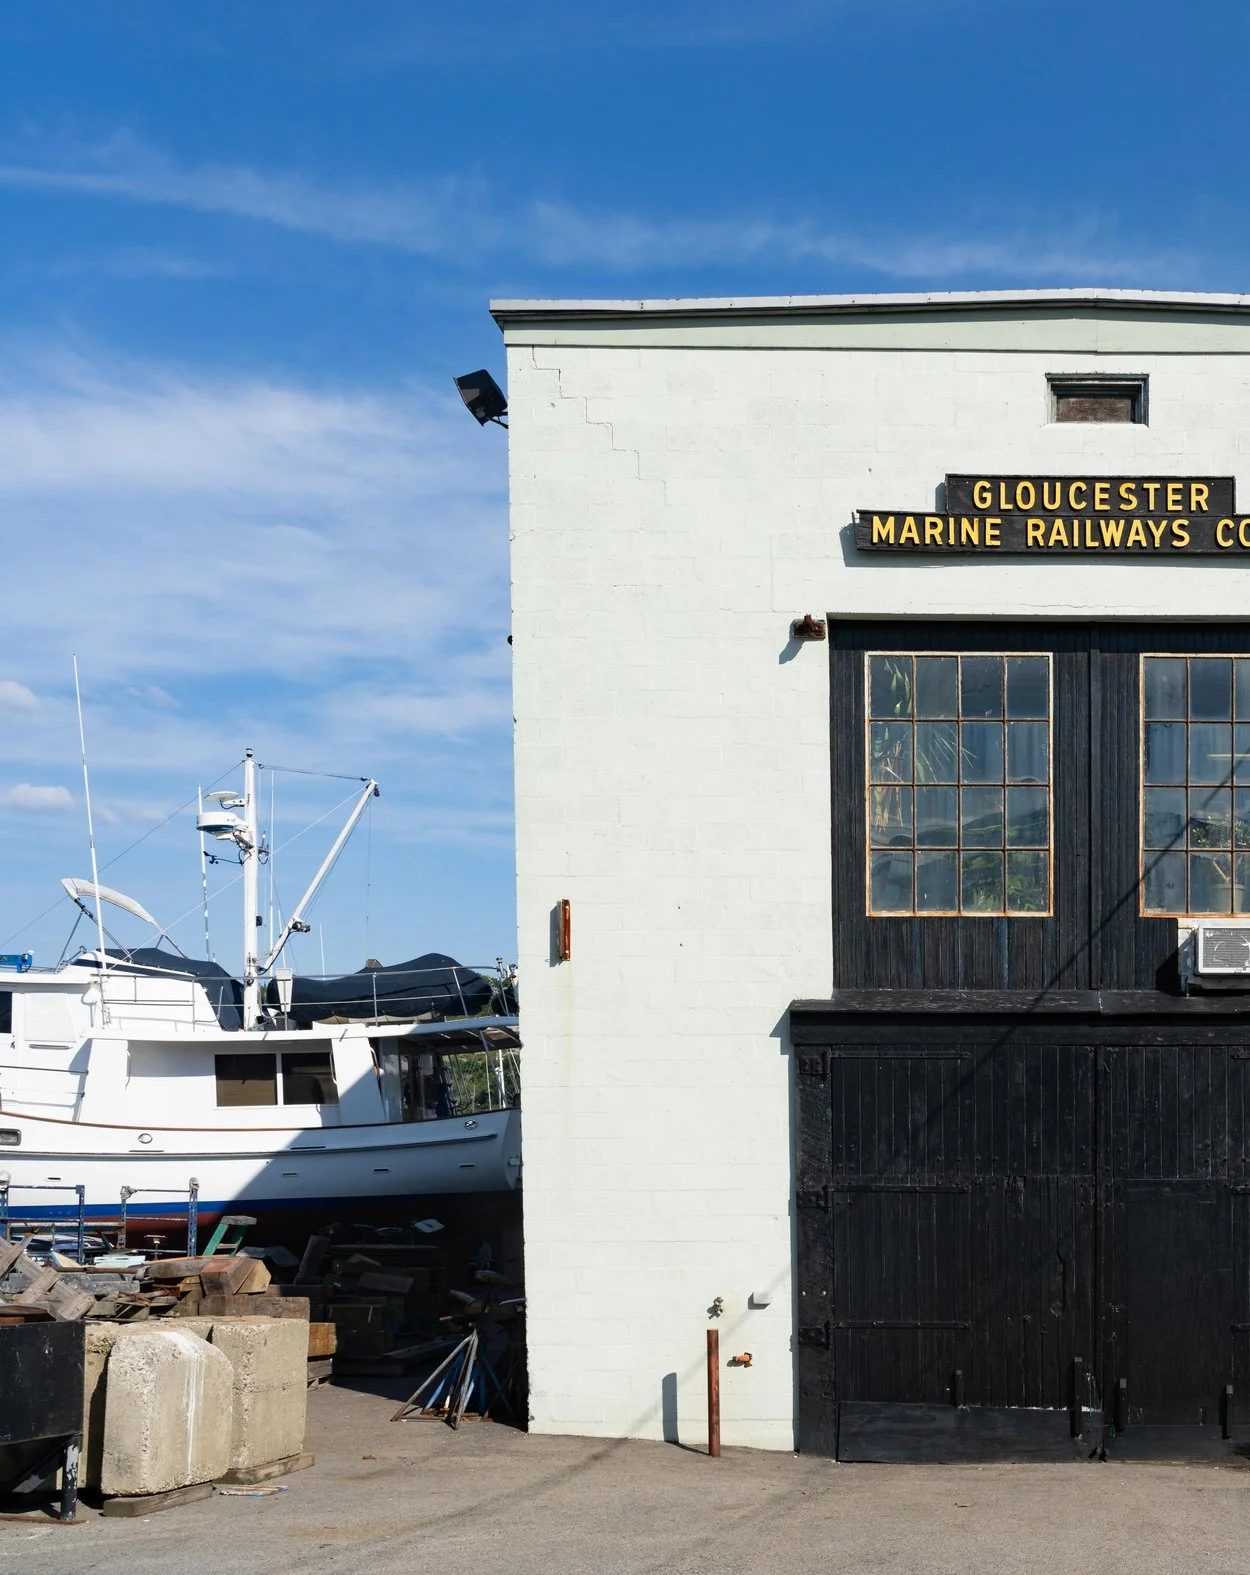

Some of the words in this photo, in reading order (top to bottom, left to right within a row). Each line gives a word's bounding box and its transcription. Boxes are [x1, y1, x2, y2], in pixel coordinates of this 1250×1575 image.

[973, 480, 1210, 511] GLOUCESTER
[872, 515, 1002, 546] MARINE
[1026, 518, 1191, 548] RAILWAYS
